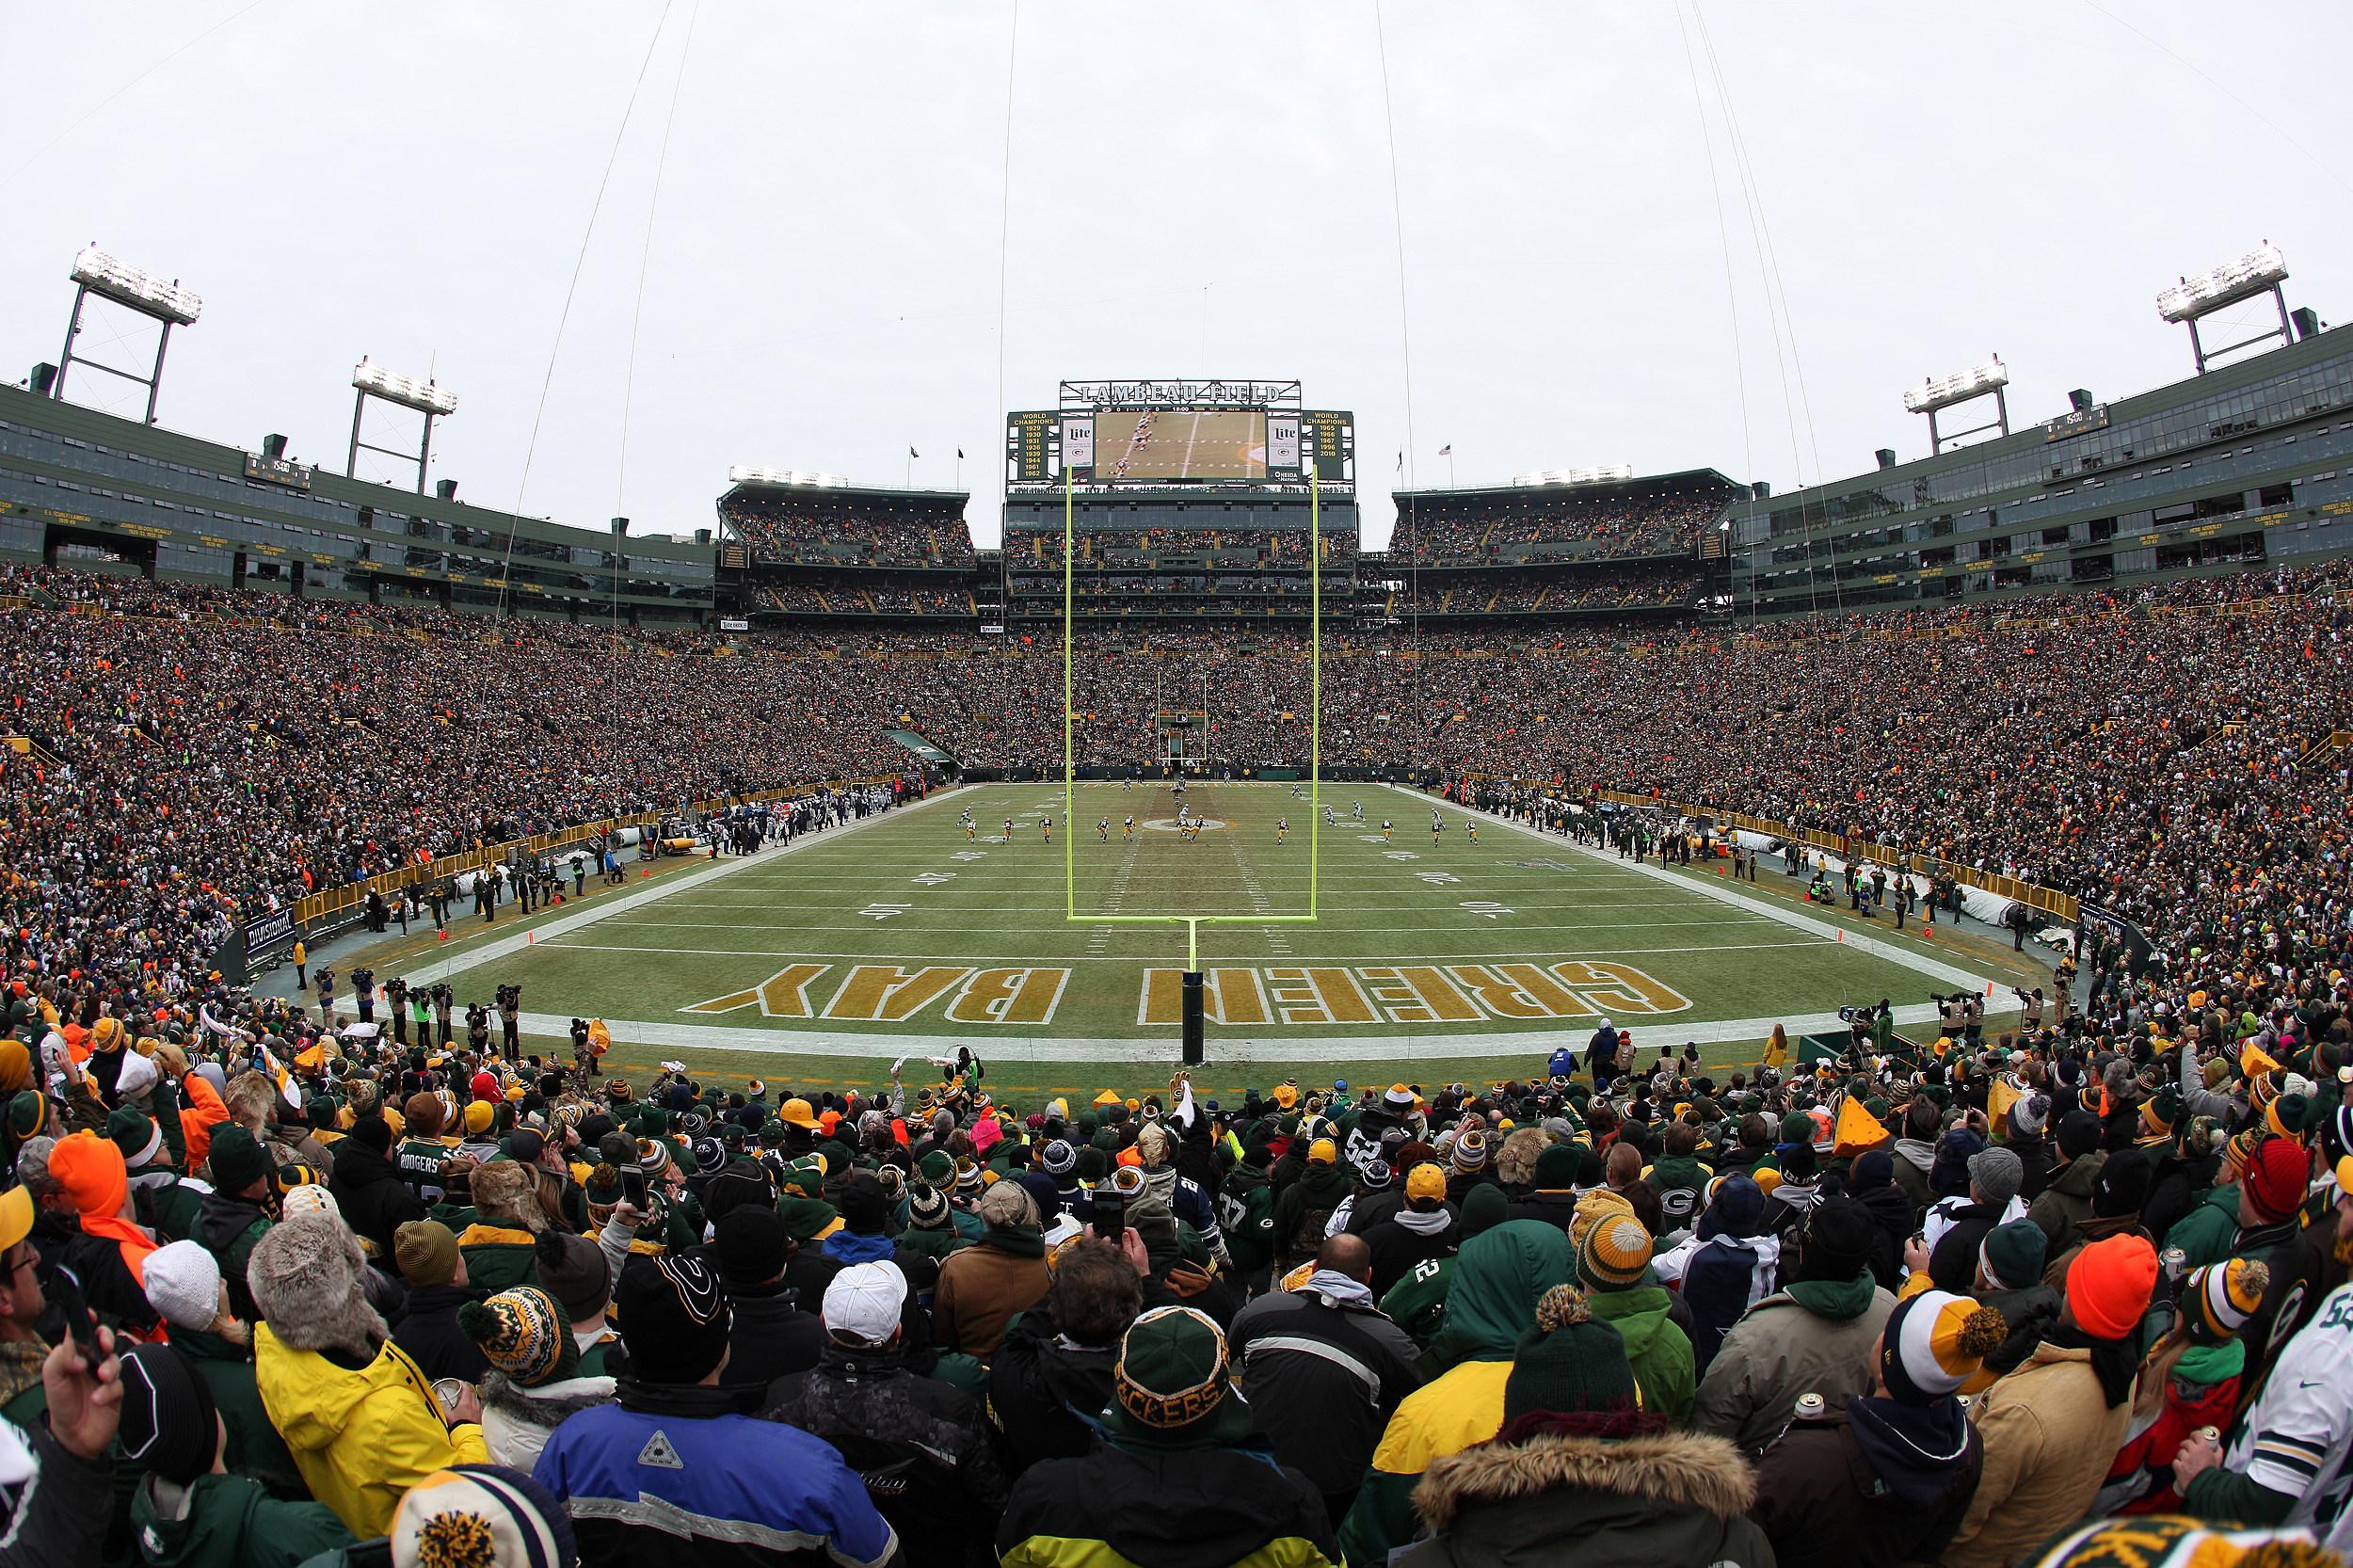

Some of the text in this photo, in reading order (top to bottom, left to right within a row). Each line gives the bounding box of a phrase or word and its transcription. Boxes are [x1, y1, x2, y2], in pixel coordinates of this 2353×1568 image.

[1081, 386, 1280, 402] LAMBEAU FIELD
[2067, 411, 2083, 424] 15:00
[1070, 428, 1090, 440] Lite
[1274, 427, 1295, 440] Lite
[273, 460, 290, 473] 15:00
[248, 910, 292, 947] DIVISIONAL
[675, 960, 1694, 1026] GREEN BAY
[1345, 1128, 1381, 1170] 52
[400, 1153, 439, 1174] RODGERS
[1043, 1150, 1076, 1174] COWBOYS
[1219, 1192, 1247, 1233] 37
